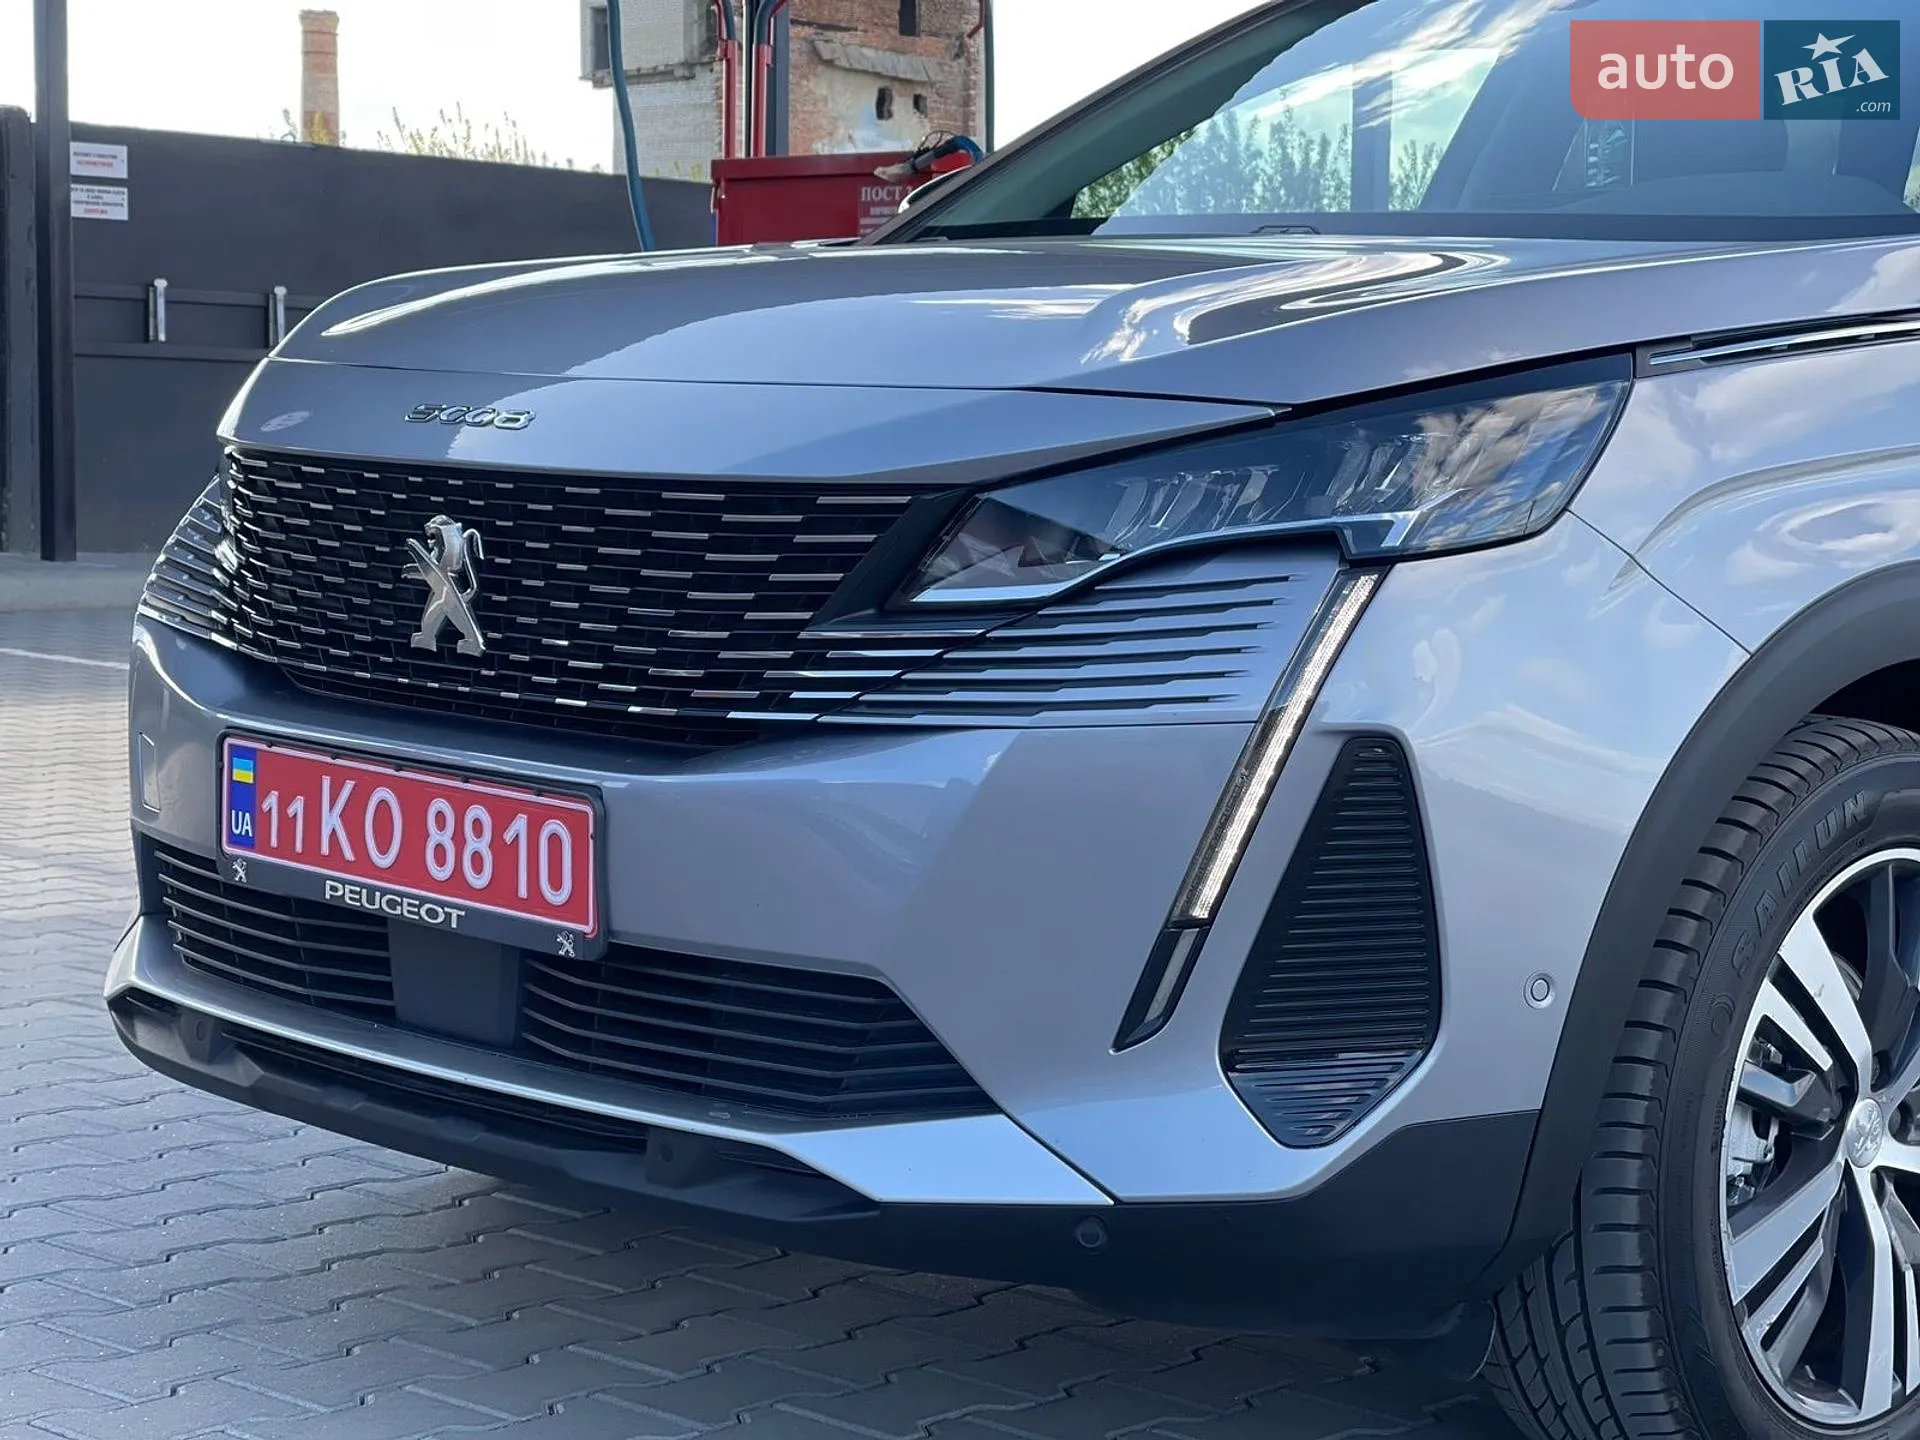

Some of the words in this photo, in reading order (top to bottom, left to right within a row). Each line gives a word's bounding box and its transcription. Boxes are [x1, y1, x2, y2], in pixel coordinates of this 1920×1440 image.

[861, 186, 902, 201] ПОСТ
[404, 403, 536, 431] 5008
[231, 809, 253, 837] UA
[424, 797, 573, 906] 8810
[324, 879, 466, 929] PEUGEOT
